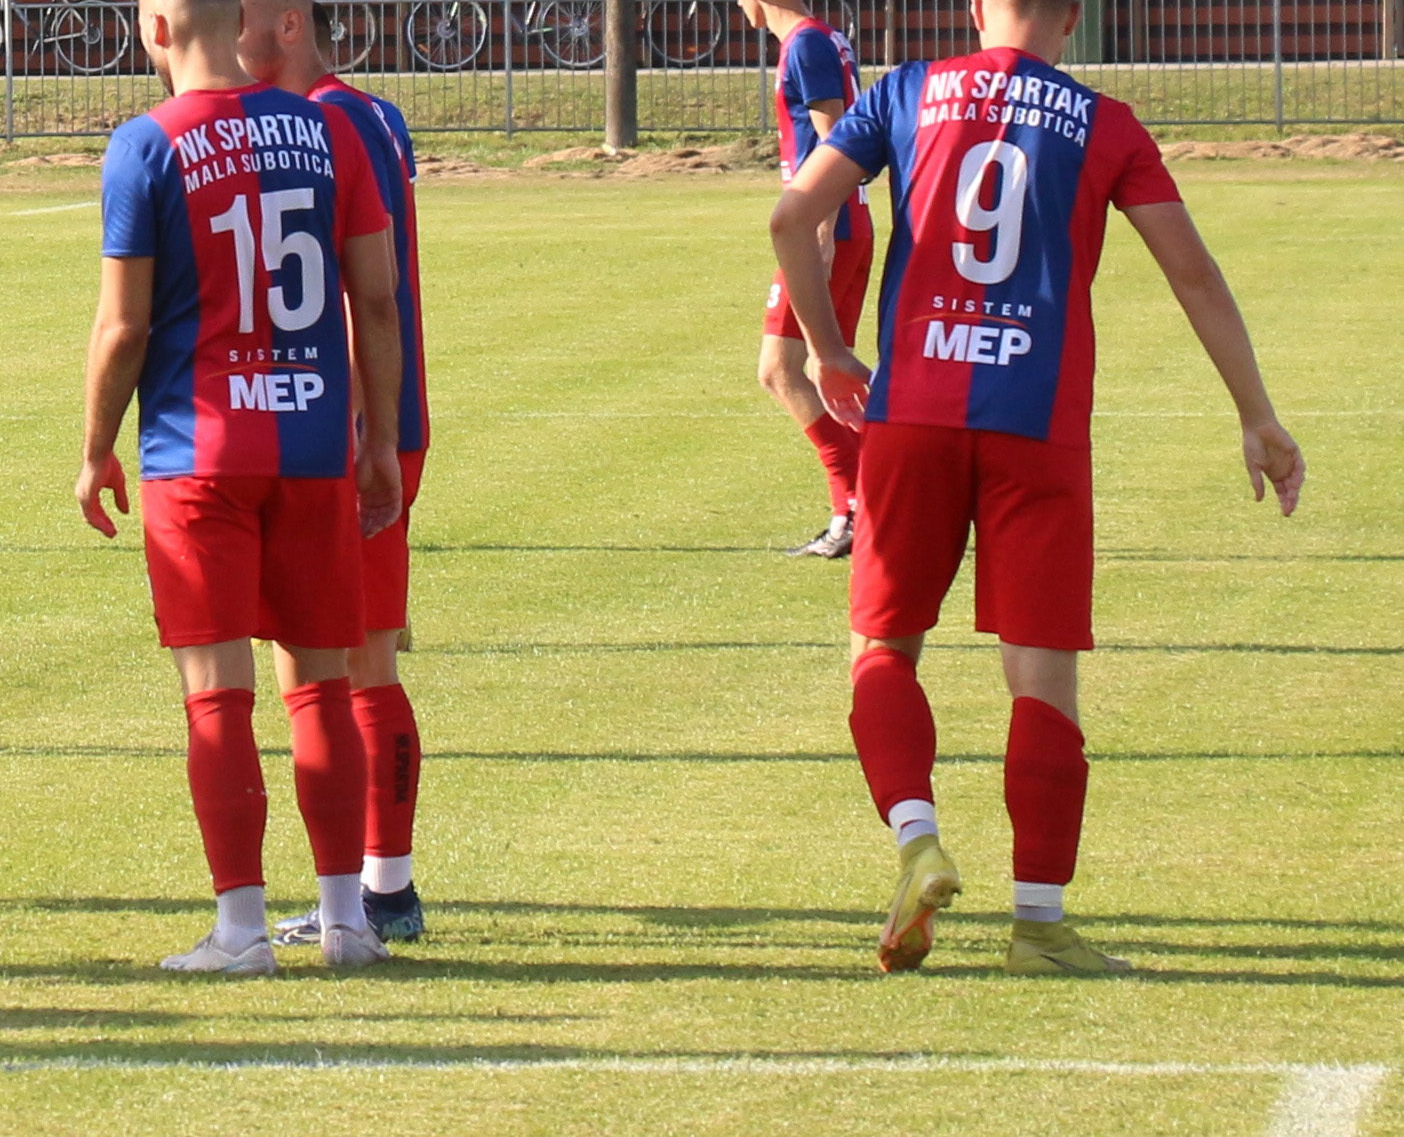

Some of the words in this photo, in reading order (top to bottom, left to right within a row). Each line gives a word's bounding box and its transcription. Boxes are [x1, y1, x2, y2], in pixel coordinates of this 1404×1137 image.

[926, 69, 967, 103] NK
[971, 70, 1091, 125] SPARTAK
[177, 125, 214, 169] NK
[215, 114, 329, 154] SPARTAK
[920, 102, 976, 128] MALA
[987, 104, 1086, 147] SUBOTICA
[184, 156, 237, 194] MALA
[241, 150, 334, 179] SUBOTICA
[951, 139, 1028, 285] 9
[209, 187, 325, 334] 15
[933, 295, 1032, 317] SISTEM
[229, 347, 318, 362] SISTEM
[923, 320, 1032, 365] MEP
[228, 372, 325, 412] MEP
